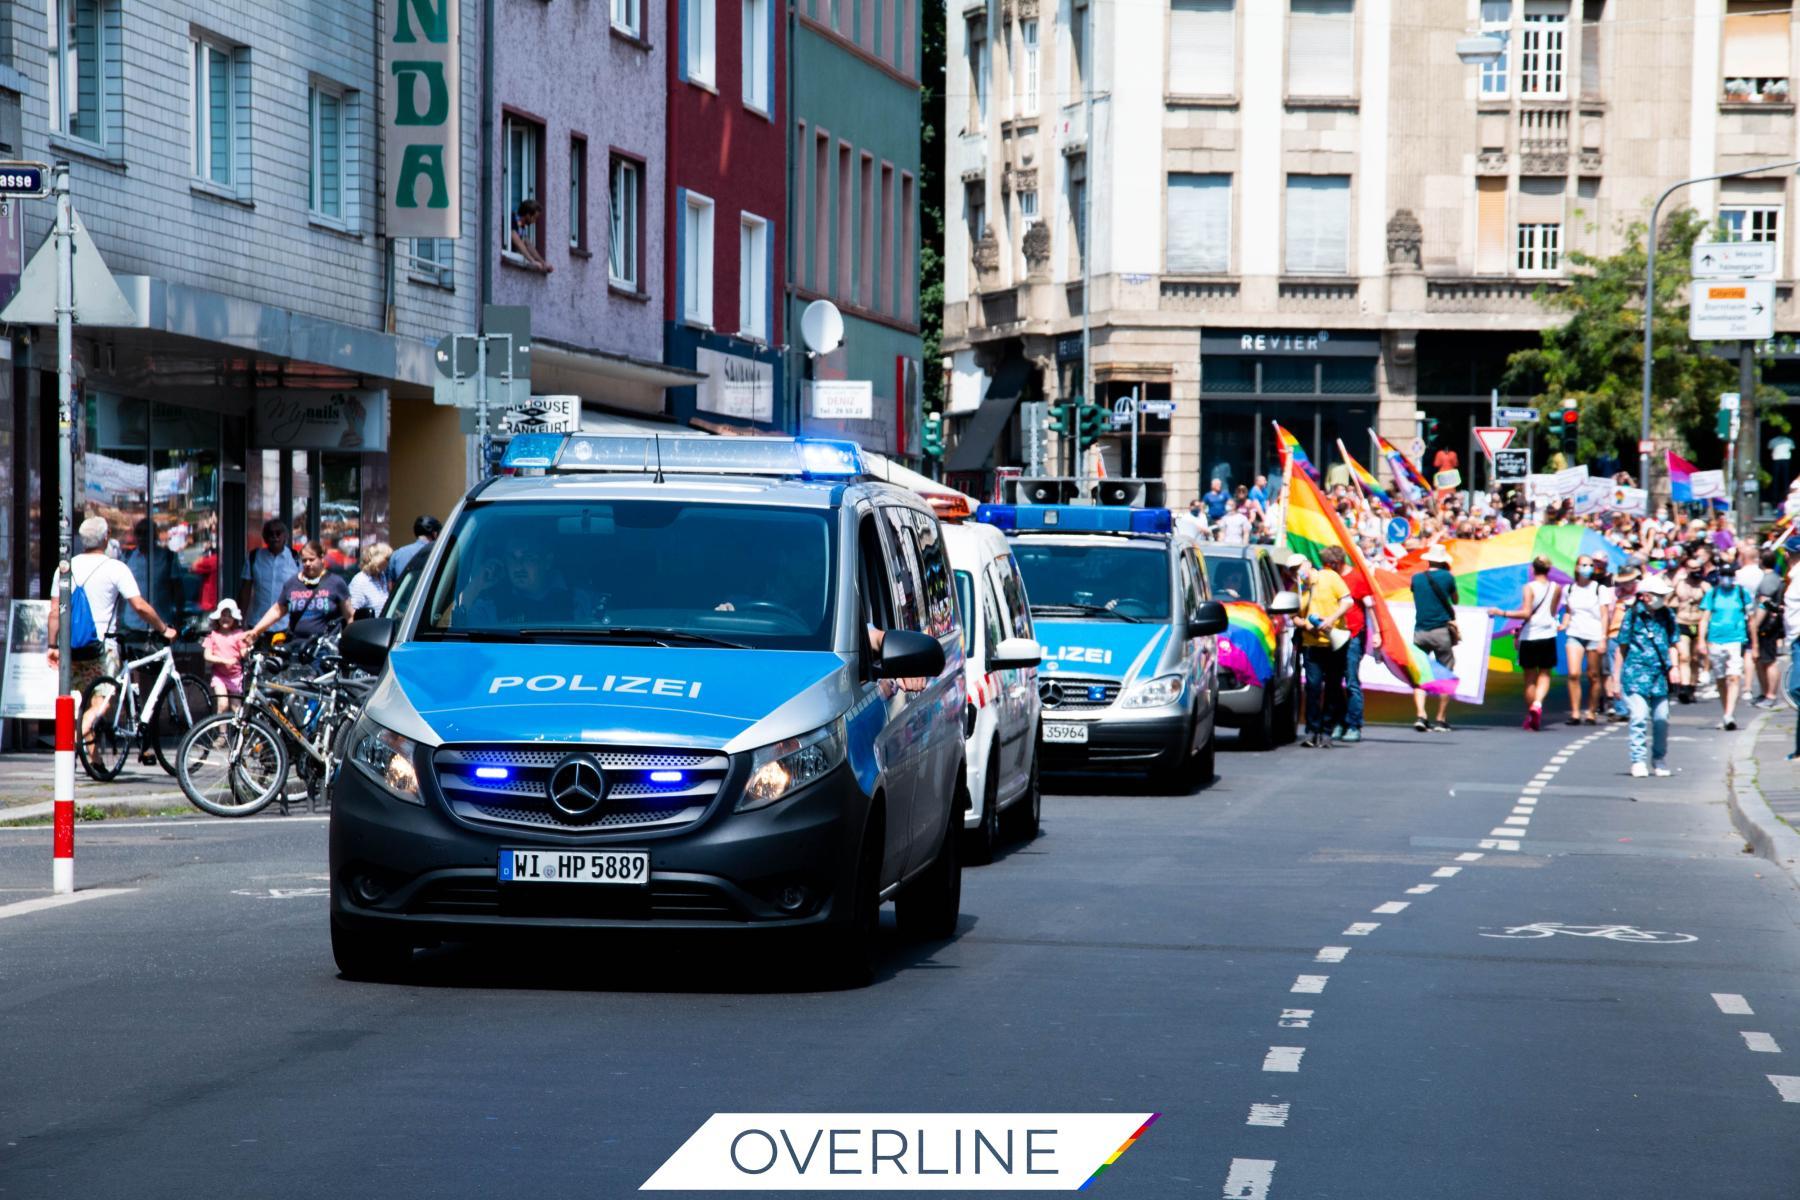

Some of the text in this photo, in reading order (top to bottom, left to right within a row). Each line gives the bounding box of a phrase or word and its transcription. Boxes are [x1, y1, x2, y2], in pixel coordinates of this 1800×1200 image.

[0, 175, 32, 188] asse
[1241, 335, 1318, 350] REVIER
[306, 404, 339, 419] nails
[1041, 646, 1113, 665] LIZEI
[488, 674, 703, 699] POLIZEI
[1046, 727, 1085, 739] 35964
[514, 854, 540, 878] WI
[558, 855, 586, 878] HP
[591, 855, 645, 879] 5889
